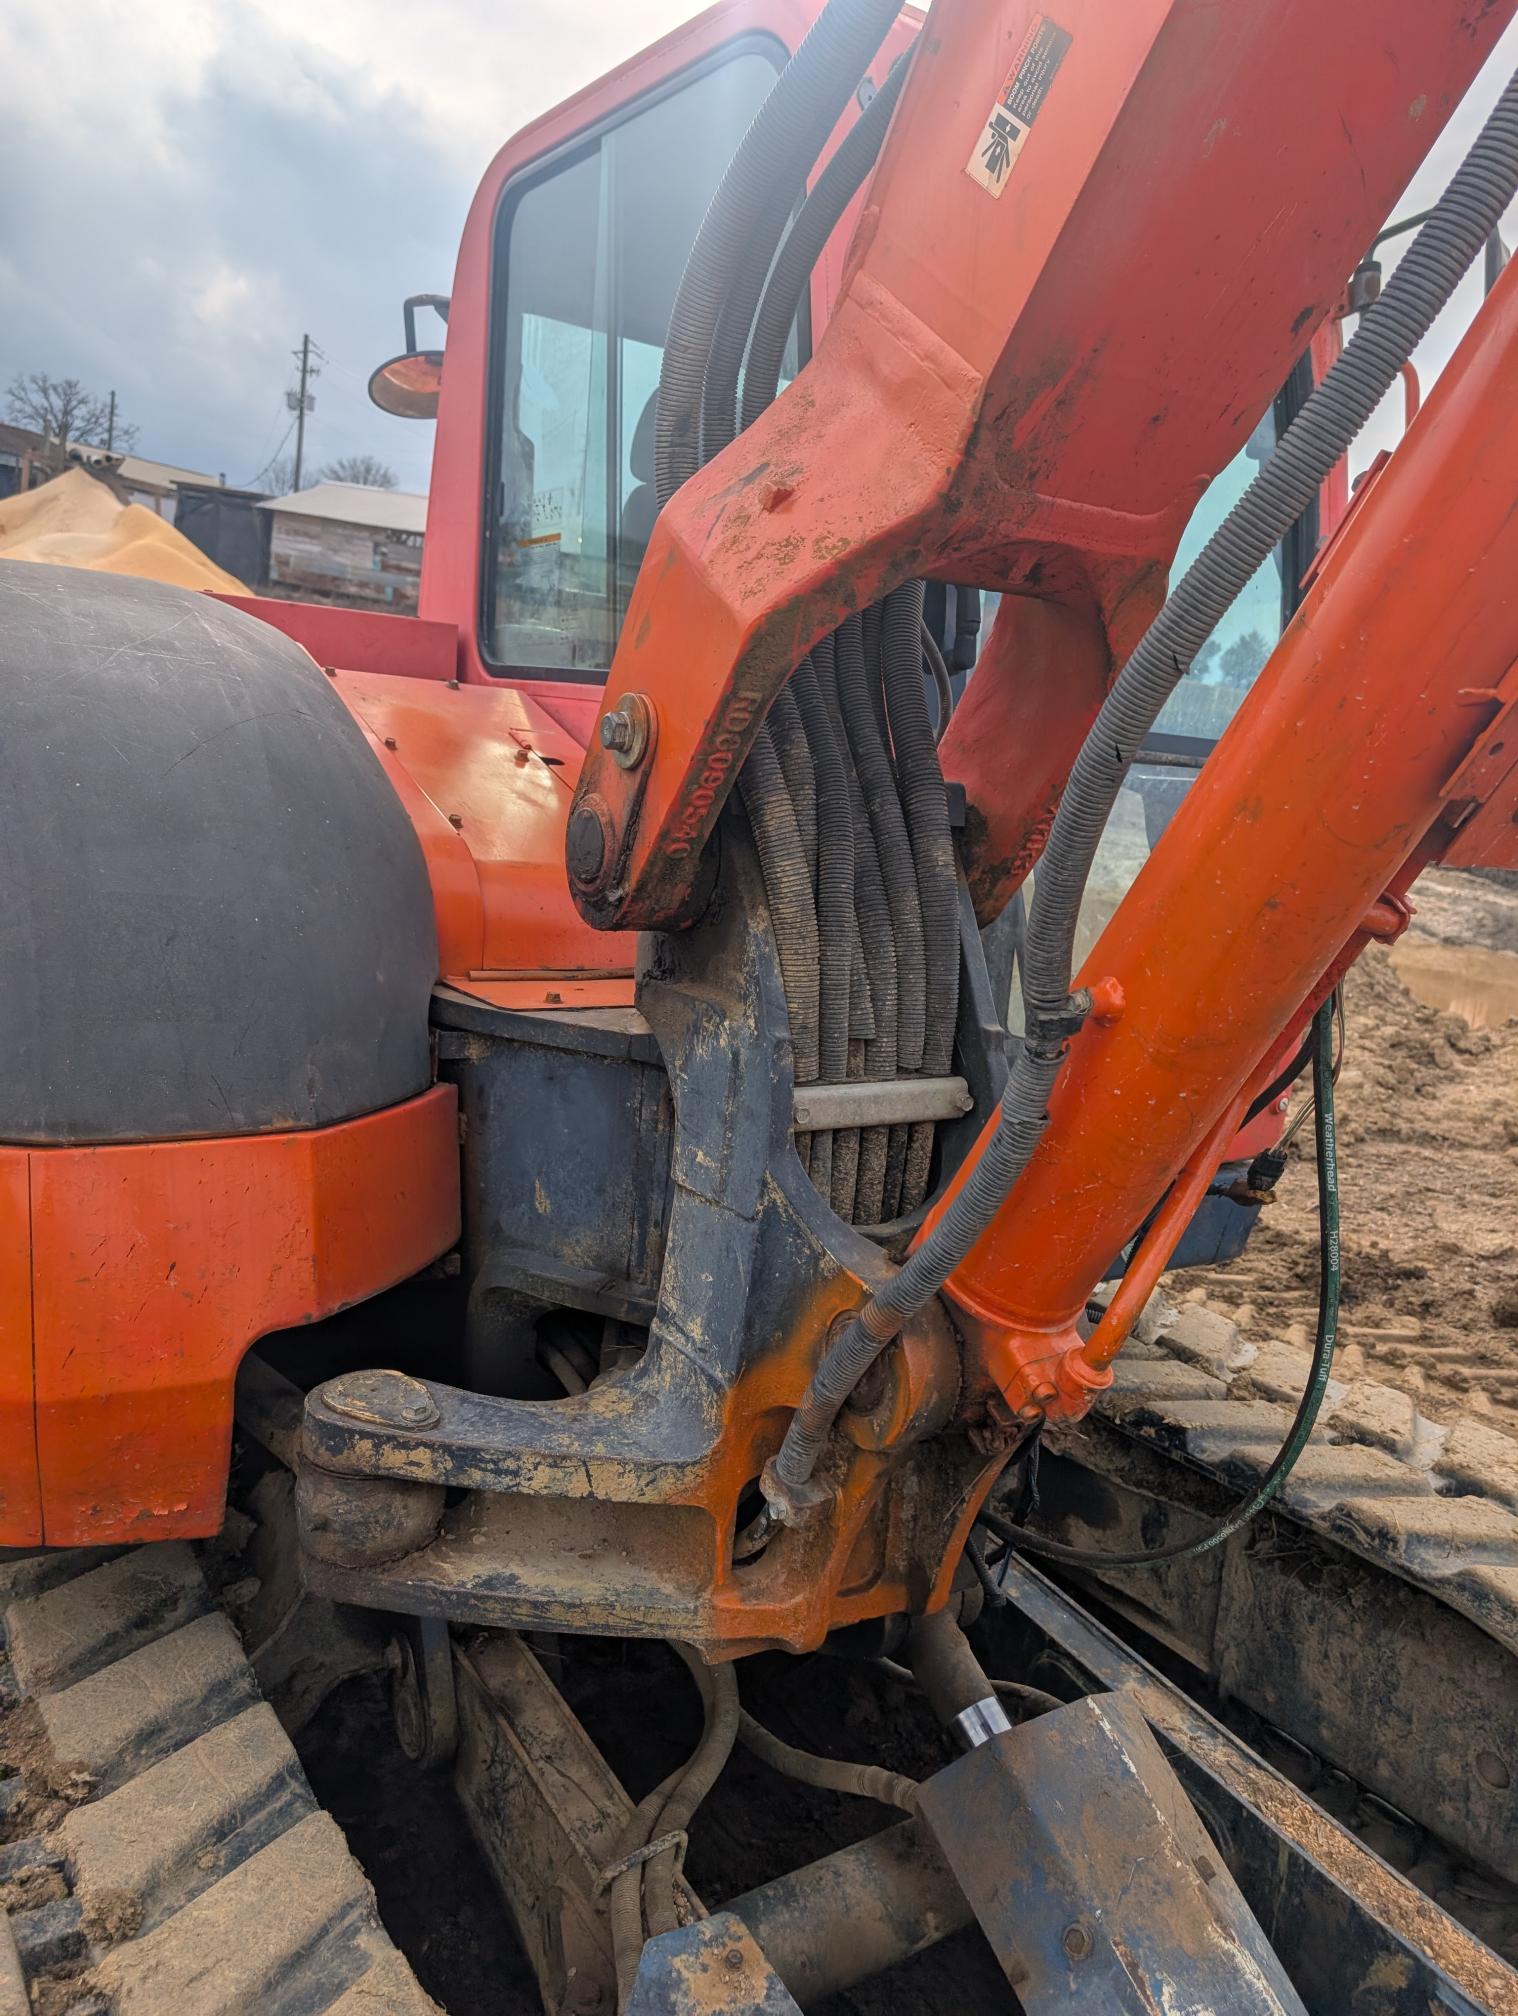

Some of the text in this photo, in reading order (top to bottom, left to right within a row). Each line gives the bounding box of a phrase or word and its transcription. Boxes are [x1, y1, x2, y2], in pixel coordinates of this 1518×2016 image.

[1008, 22, 1038, 81] WARNING
[1023, 73, 1031, 86] out
[1030, 61, 1036, 71] of
[1007, 81, 1020, 105] BOOM
[1018, 55, 1032, 79] PINCH
[1022, 58, 1051, 116] personal injury
[1026, 84, 1032, 93] to
[1031, 60, 1043, 82] avoid
[1026, 111, 1032, 120] or
[1324, 1113, 1337, 1192] Weatherhead
[1330, 1230, 1340, 1272] H28004
[1317, 1334, 1335, 1381] Dura-Tuff
